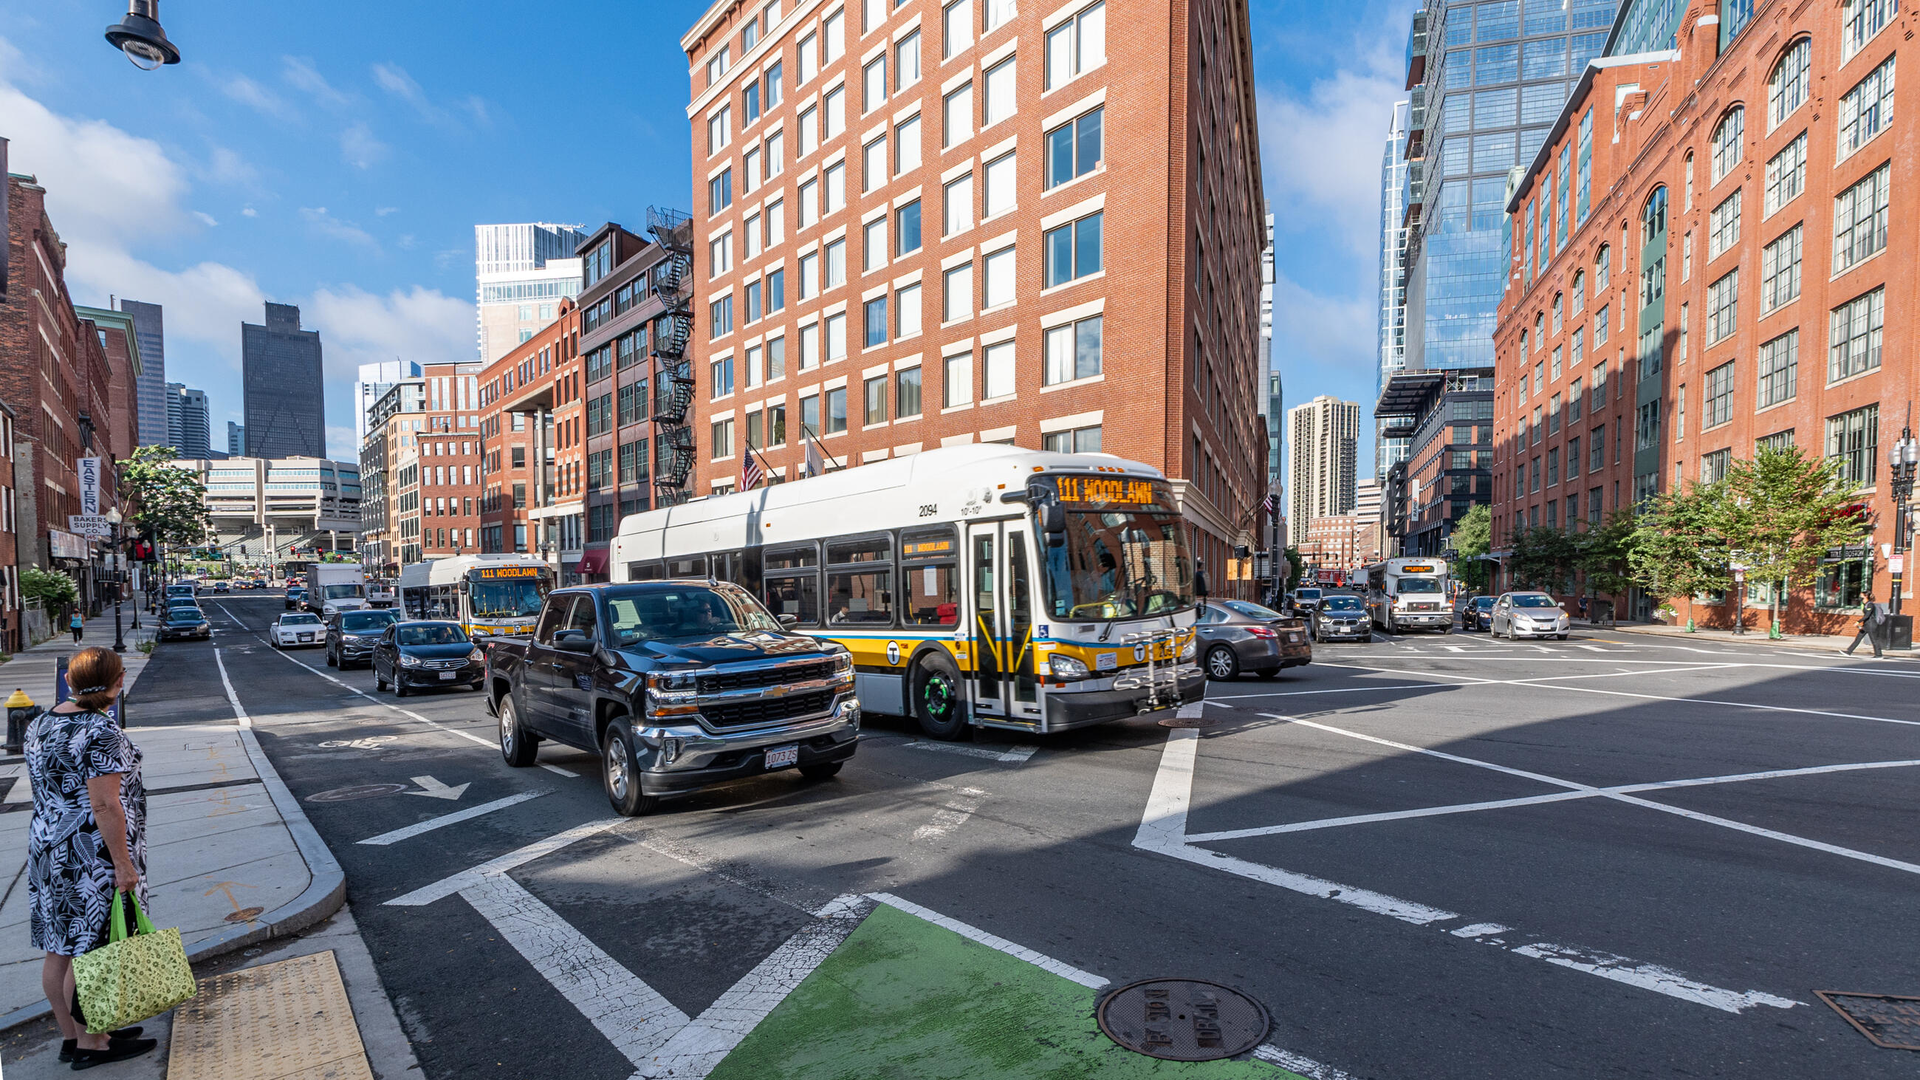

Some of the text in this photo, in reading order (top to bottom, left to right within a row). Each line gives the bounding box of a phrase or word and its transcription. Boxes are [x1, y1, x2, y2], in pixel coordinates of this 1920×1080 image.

[83, 460, 96, 513] EASTERN
[1057, 477, 1152, 504] 111 WOODLAWN
[919, 503, 938, 517] 2094
[903, 541, 949, 554] 111 WOODLAWN
[481, 568, 537, 578] 111 WOODLAWN
[889, 647, 898, 662] T
[1135, 647, 1144, 660] T
[767, 750, 797, 764] 1073 ZS
